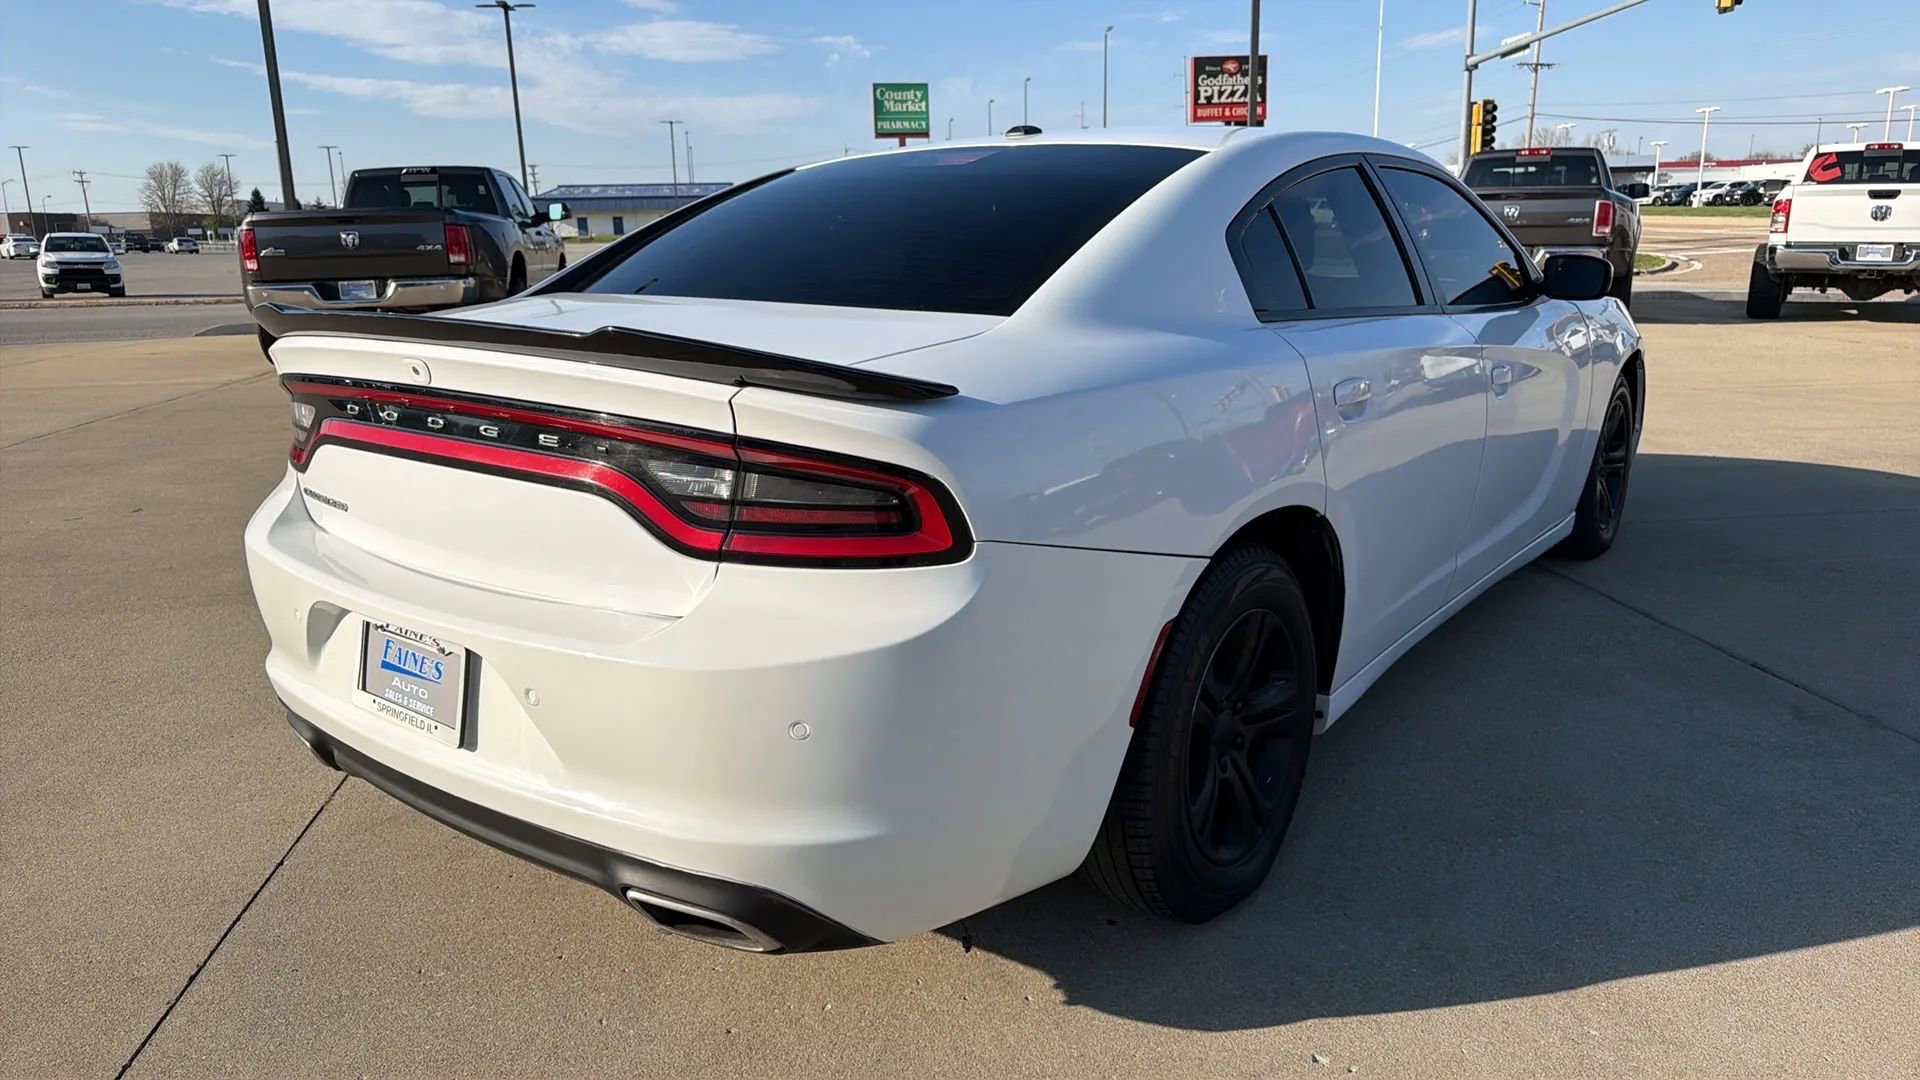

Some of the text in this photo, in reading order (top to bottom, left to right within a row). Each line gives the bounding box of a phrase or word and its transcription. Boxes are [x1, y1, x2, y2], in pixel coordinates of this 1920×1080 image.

[1198, 73, 1262, 86] Godfathes
[876, 88, 924, 102] County
[883, 100, 926, 112] Market
[1197, 106, 1262, 117] BUFFET & CHICN
[877, 120, 926, 129] PHARMACY
[346, 403, 560, 448] DODGE
[385, 622, 440, 647] FAINE'S
[383, 638, 444, 680] FAINE'S
[391, 676, 428, 700] AUTO
[384, 688, 402, 704] SALES
[409, 698, 434, 717] SERVICE
[376, 701, 434, 735] SPRINGFIELD IL
